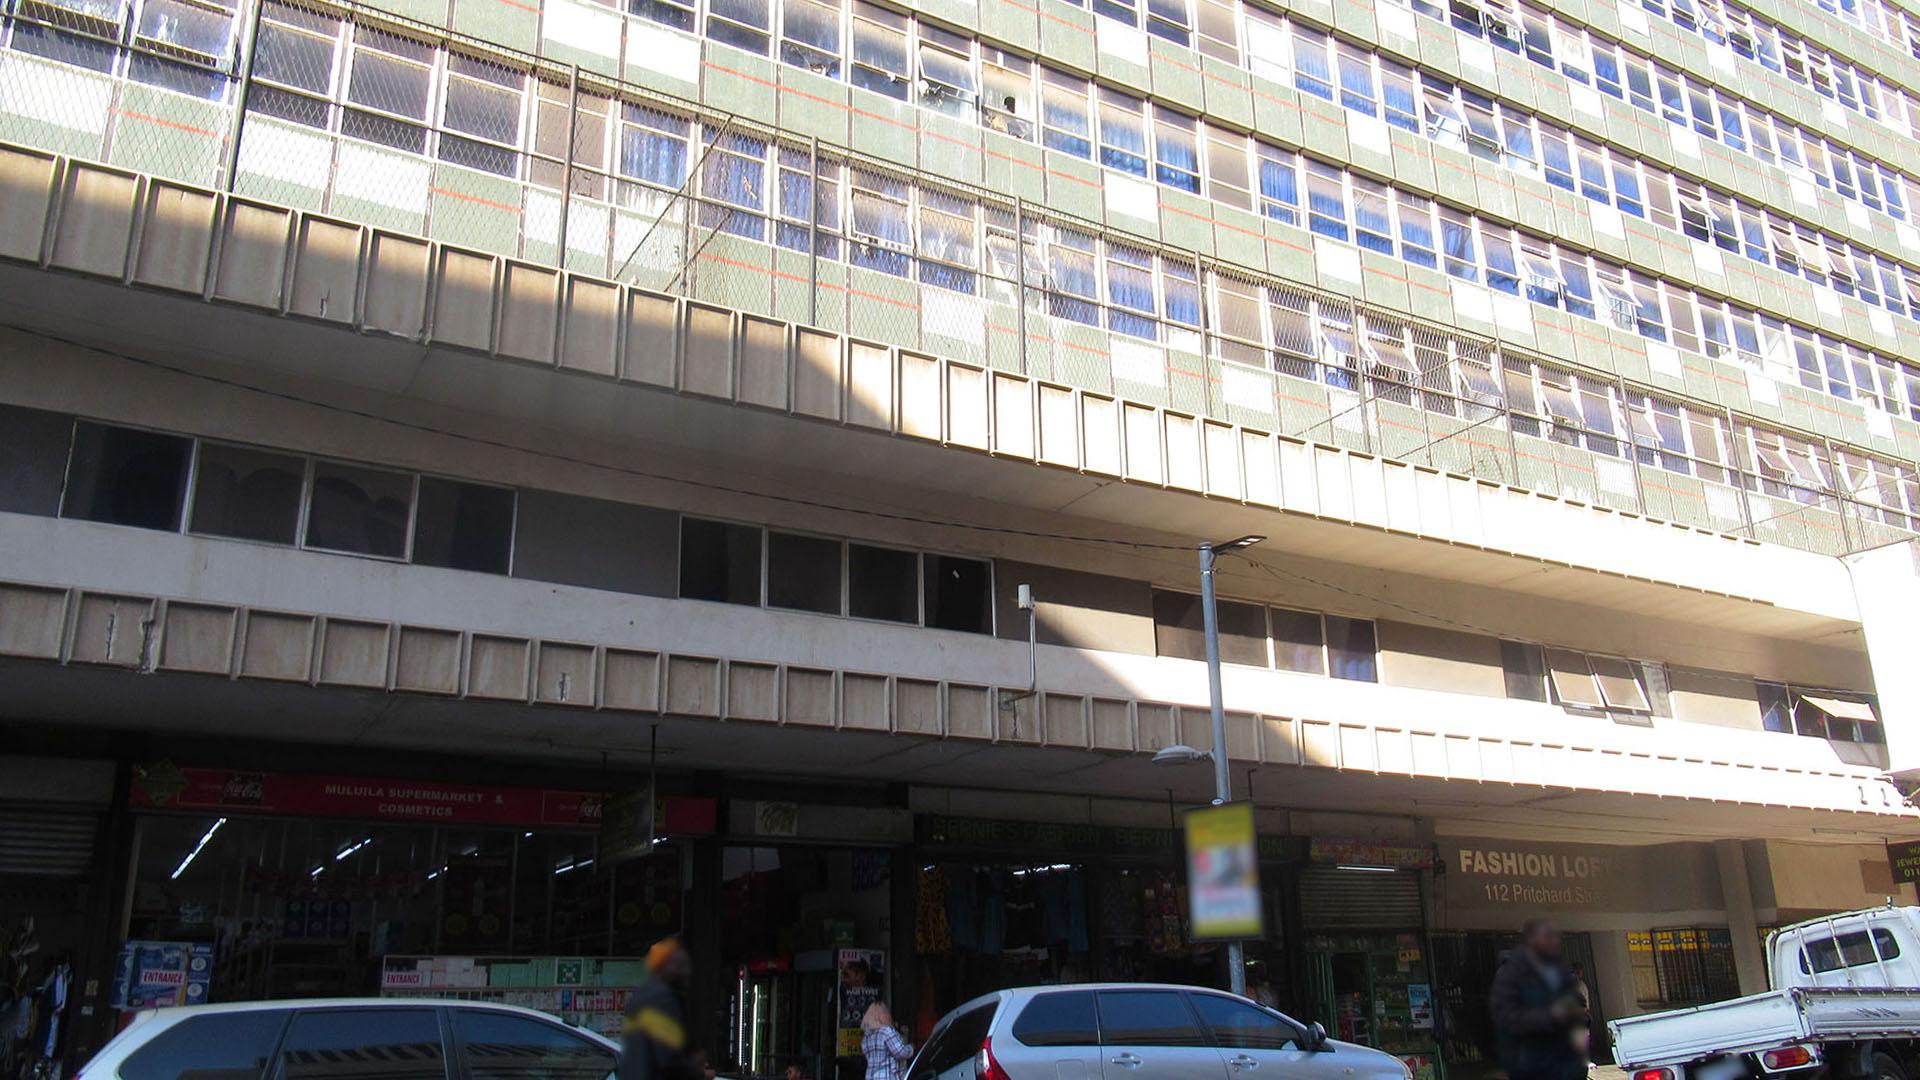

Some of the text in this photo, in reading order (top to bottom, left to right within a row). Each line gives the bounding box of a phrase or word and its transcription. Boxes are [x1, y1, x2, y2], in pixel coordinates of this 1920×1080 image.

[388, 787, 484, 804] SUPERMARKET
[495, 794, 504, 805] &
[378, 804, 453, 817] COSMETICS
[1458, 848, 1556, 878] FASHION
[1485, 883, 1509, 903] 112
[1512, 883, 1572, 904] Pritchard
[143, 971, 183, 985] ENTRANCE
[386, 973, 421, 986] ENTRANCE
